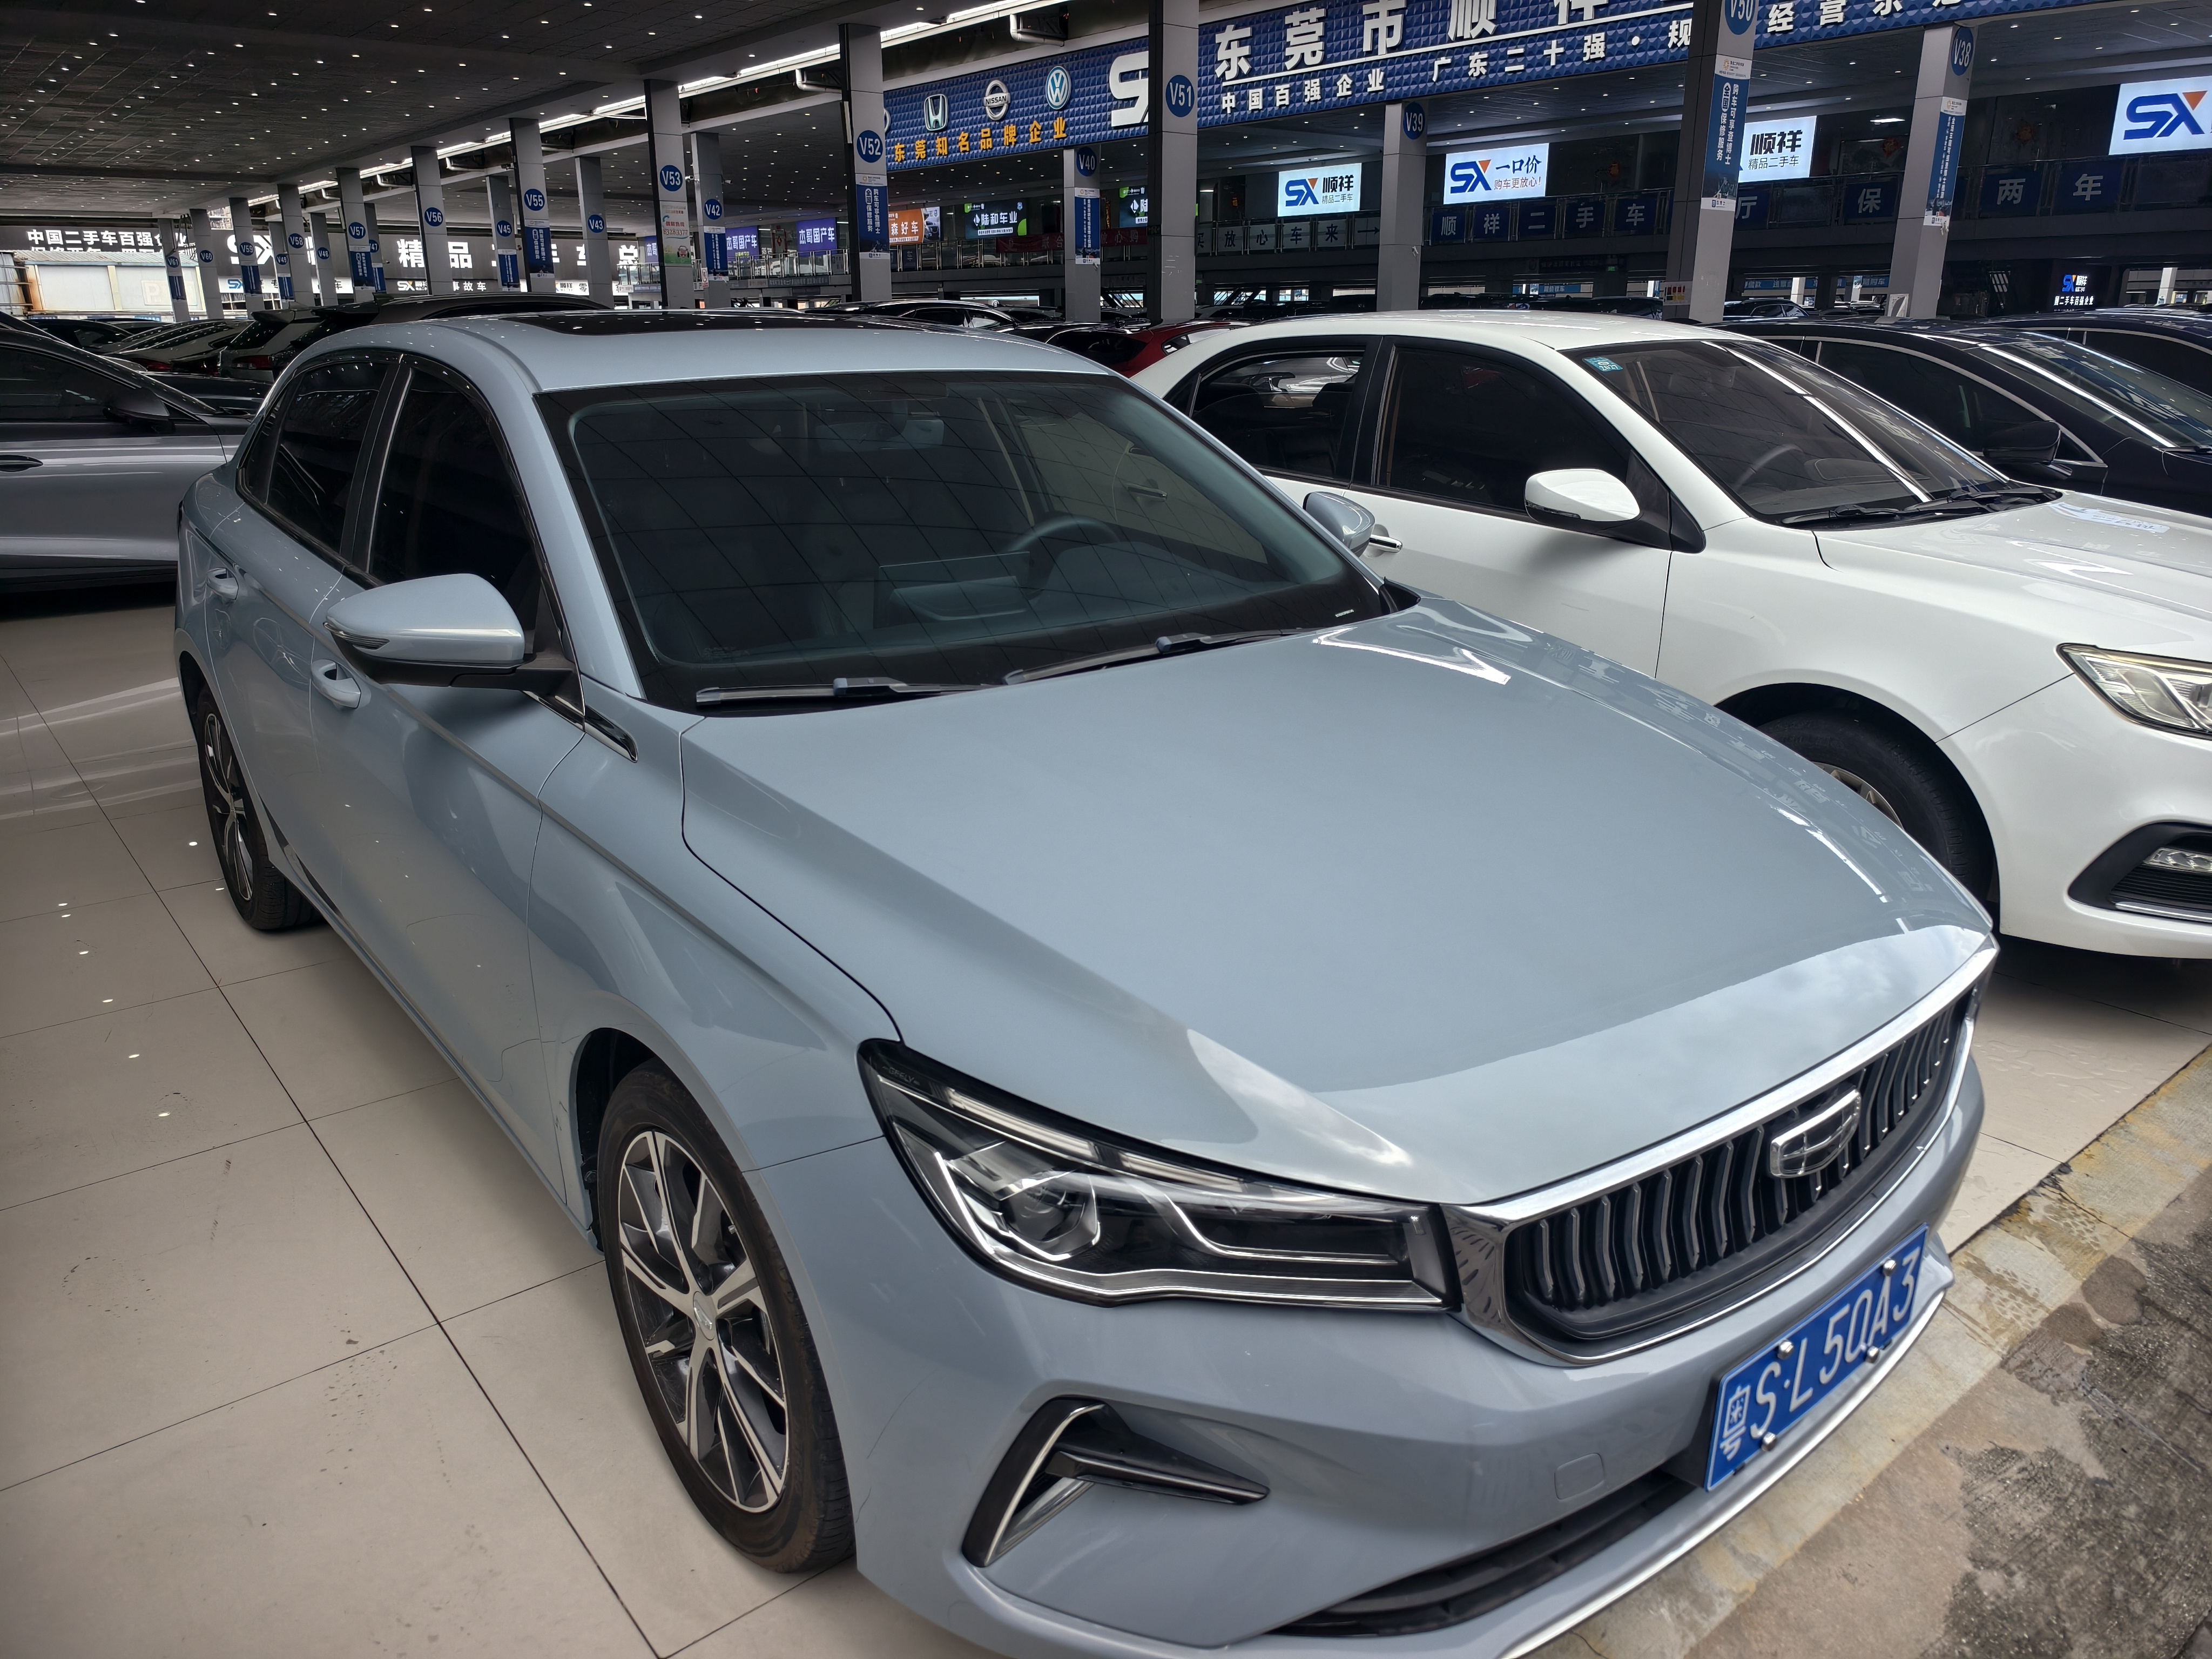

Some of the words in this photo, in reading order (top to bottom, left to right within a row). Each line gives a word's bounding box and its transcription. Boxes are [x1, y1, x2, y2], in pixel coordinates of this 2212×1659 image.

[1730, 0, 1754, 21] V50
[1954, 38, 1971, 67] V38
[1169, 80, 1193, 107] V51
[1222, 68, 1385, 114] 中国百强企业
[986, 95, 1007, 106] NISSAN
[1406, 112, 1423, 132] V39
[2123, 90, 2208, 140] SX
[1725, 84, 1739, 165] 购车可享查博士
[859, 137, 881, 156] V52
[894, 116, 1067, 163] 东莞知名品牌企业
[1750, 130, 1803, 156] 顺祥
[1078, 154, 1096, 171] V40
[1495, 155, 1542, 174] 一口价
[1748, 155, 1799, 170] 精品二手车
[662, 170, 681, 186] V53
[1323, 174, 1354, 193] 顺祥
[1450, 159, 1492, 194] SX
[526, 193, 543, 207] V55
[1285, 178, 1319, 207] SX
[1321, 193, 1353, 204] 精品二手车
[705, 203, 720, 216] V42
[1441, 203, 1645, 236] 顺祥二手车
[1858, 188, 1881, 213] 保
[1997, 173, 2103, 205] 两年
[426, 211, 442, 222] V56
[589, 219, 603, 230] V43
[981, 211, 1017, 226] 陆和车业
[349, 226, 364, 236] V57
[498, 224, 511, 234] V45
[799, 227, 835, 244] 杰哥国产车
[241, 244, 253, 253] V59
[289, 235, 304, 246] V58
[726, 234, 757, 251] 杰哥国产车
[201, 252, 212, 260] V60
[318, 249, 329, 257] V48
[448, 241, 473, 268] 品
[168, 258, 178, 266] V61
[397, 281, 415, 291] SX
[888, 1067, 915, 1083] GEELY
